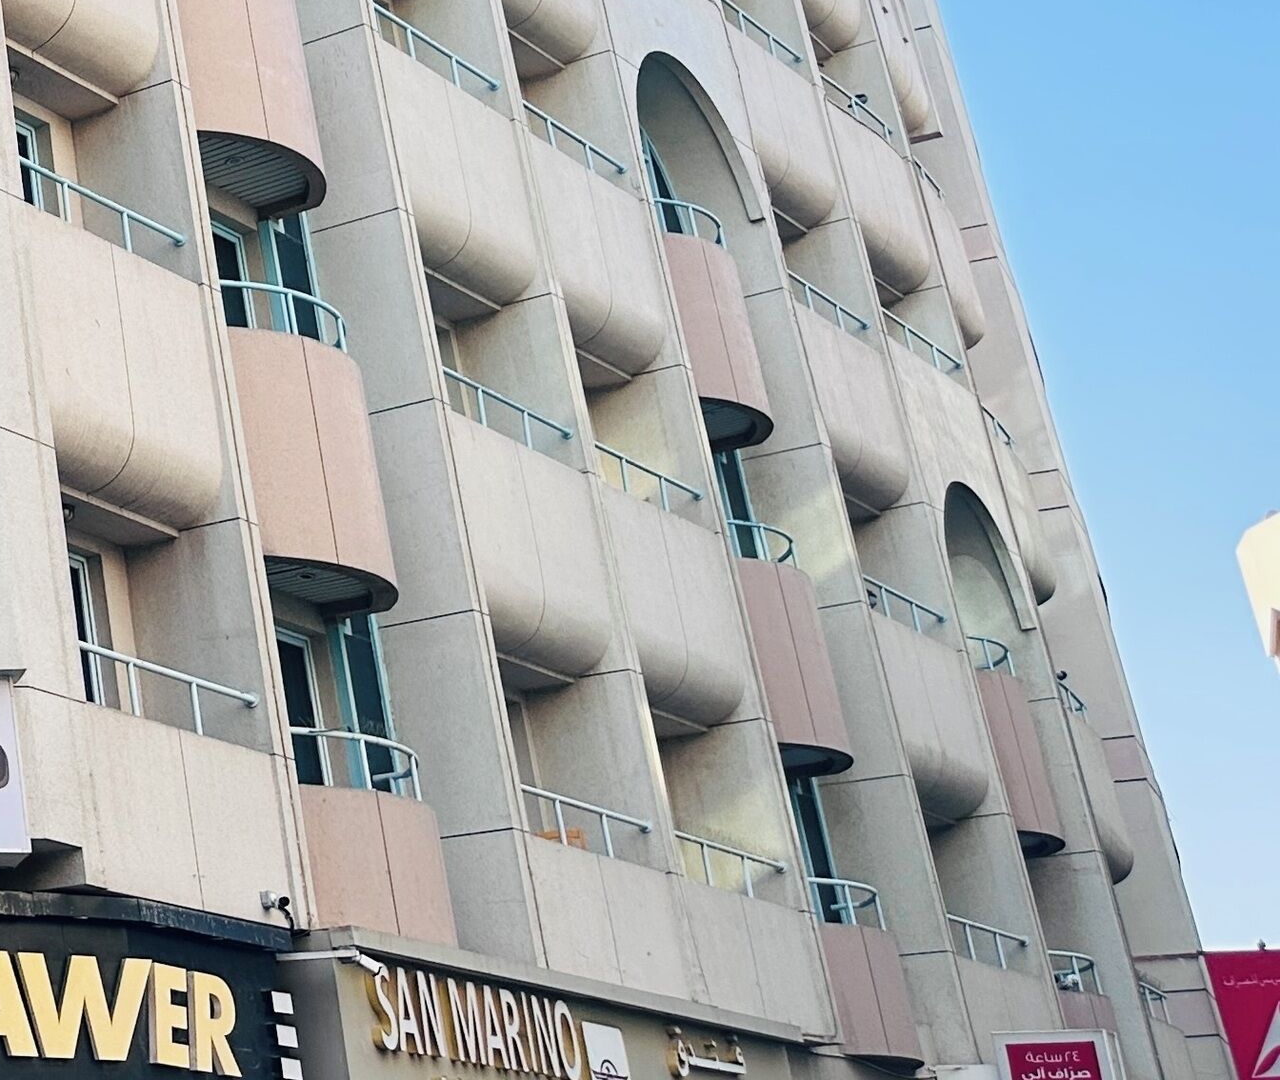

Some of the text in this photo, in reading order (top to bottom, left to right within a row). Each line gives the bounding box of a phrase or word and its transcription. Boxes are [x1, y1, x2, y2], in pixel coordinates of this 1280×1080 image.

[371, 964, 582, 1080] SAN MARINO
[670, 1026, 747, 1077] فندق
[1025, 1050, 1063, 1063] ساعة
